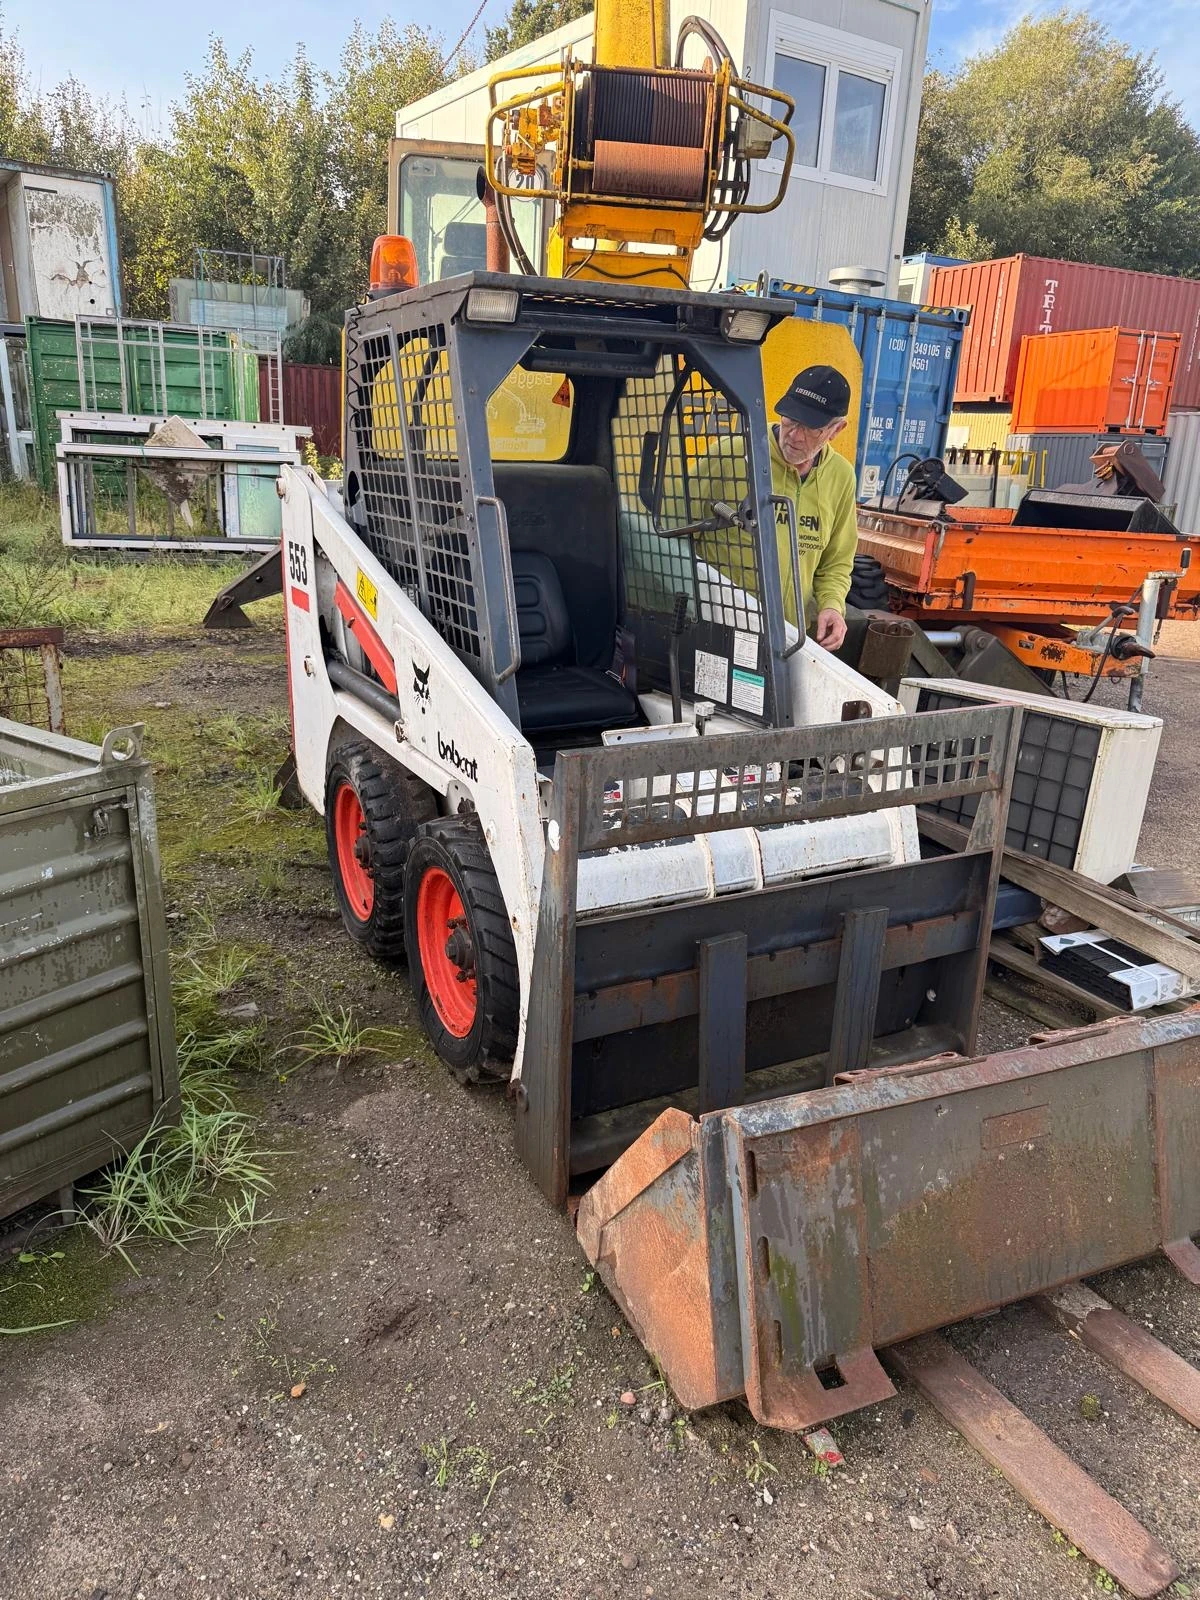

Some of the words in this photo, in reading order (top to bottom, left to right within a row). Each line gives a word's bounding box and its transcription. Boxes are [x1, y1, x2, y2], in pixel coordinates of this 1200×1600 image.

[888, 338, 907, 352] ICOU
[914, 342, 940, 357] 349105
[944, 346, 951, 359] 6
[912, 358, 929, 371] 45G1
[795, 387, 827, 405] LIEBHERR
[288, 541, 308, 586] 553
[437, 730, 479, 783] bobcat
